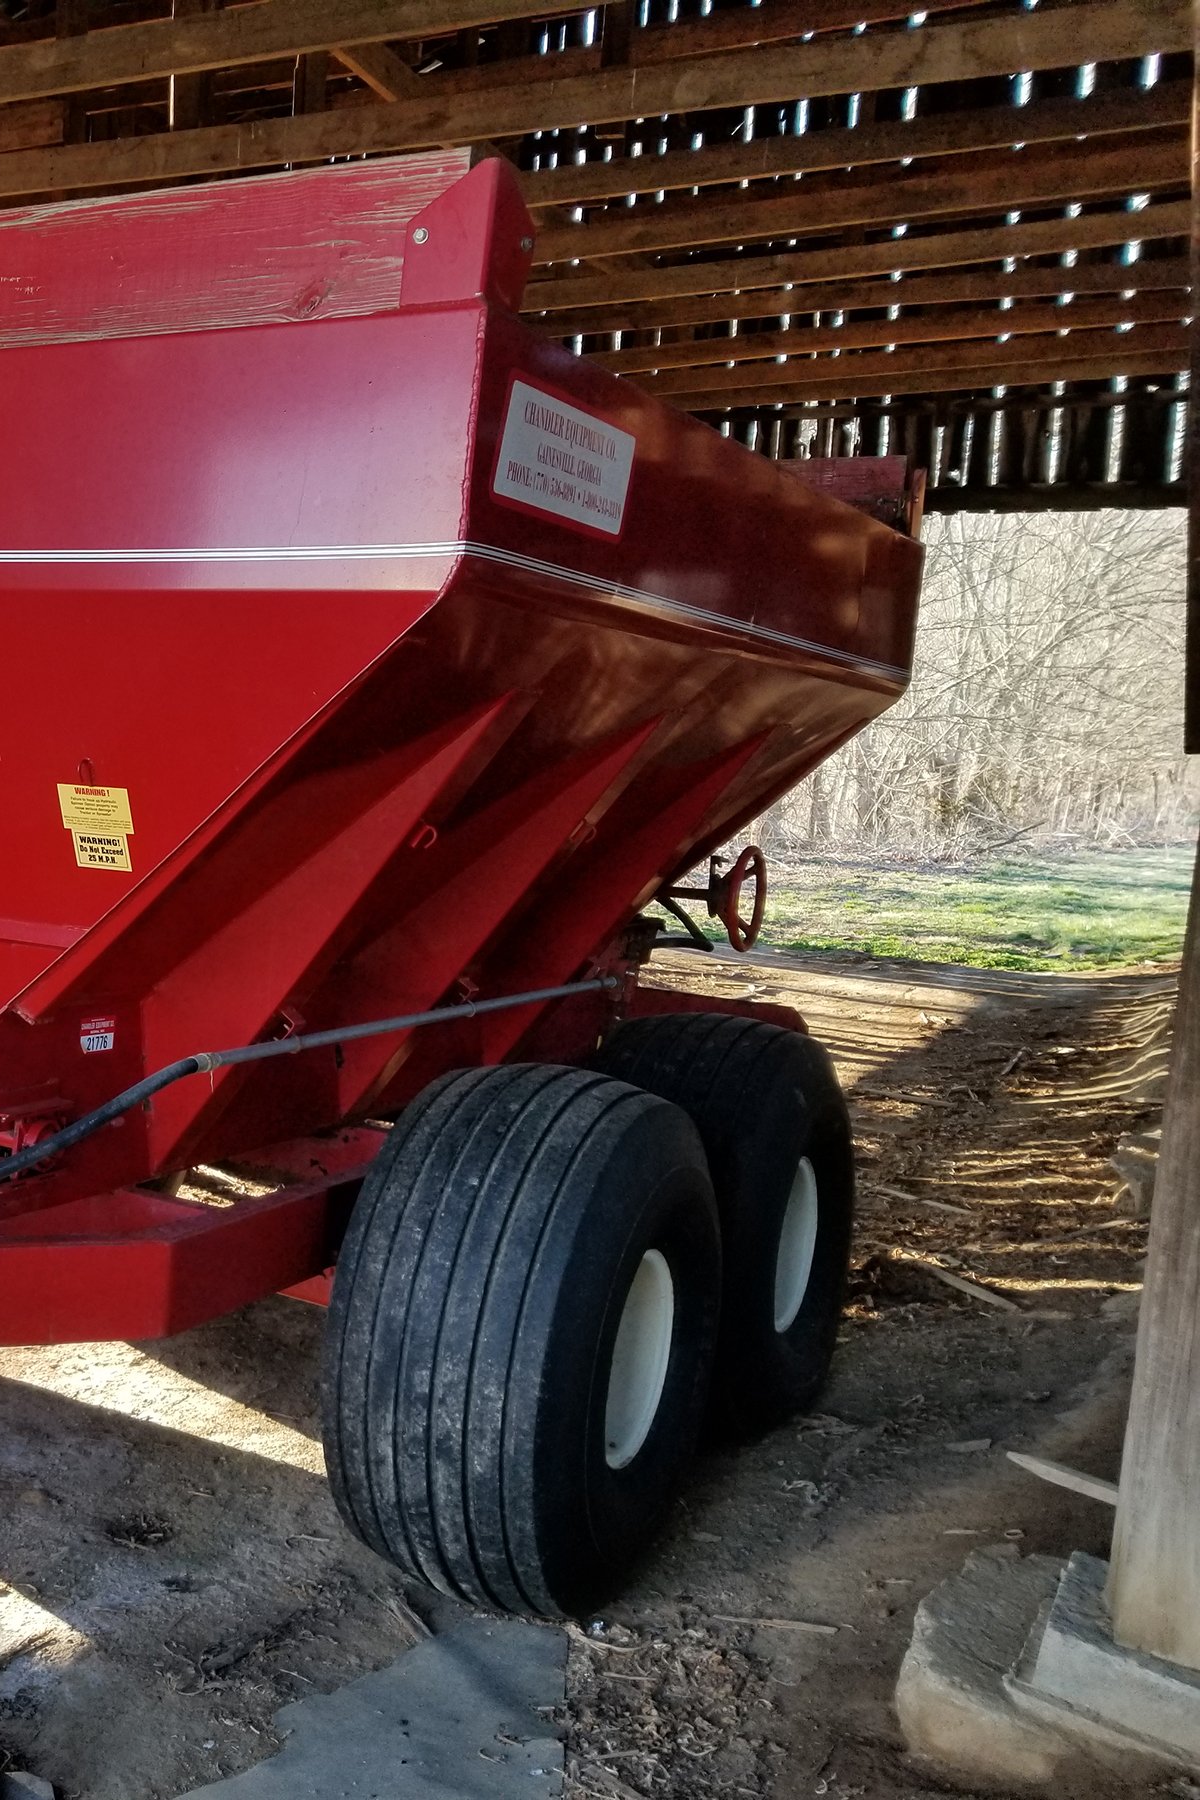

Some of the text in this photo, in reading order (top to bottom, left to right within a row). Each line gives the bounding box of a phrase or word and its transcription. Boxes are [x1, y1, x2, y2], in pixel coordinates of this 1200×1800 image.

[524, 401, 617, 463] CHANDLER EQUIPMENT CO.
[506, 460, 533, 488] PHONE:
[533, 472, 550, 495] (770)
[576, 458, 602, 487] GEORGIA
[79, 835, 121, 847] WARNING!
[79, 844, 124, 856] Do Not Exceed
[88, 854, 118, 864] 25 M.P.H.
[86, 1035, 108, 1050] 21776
